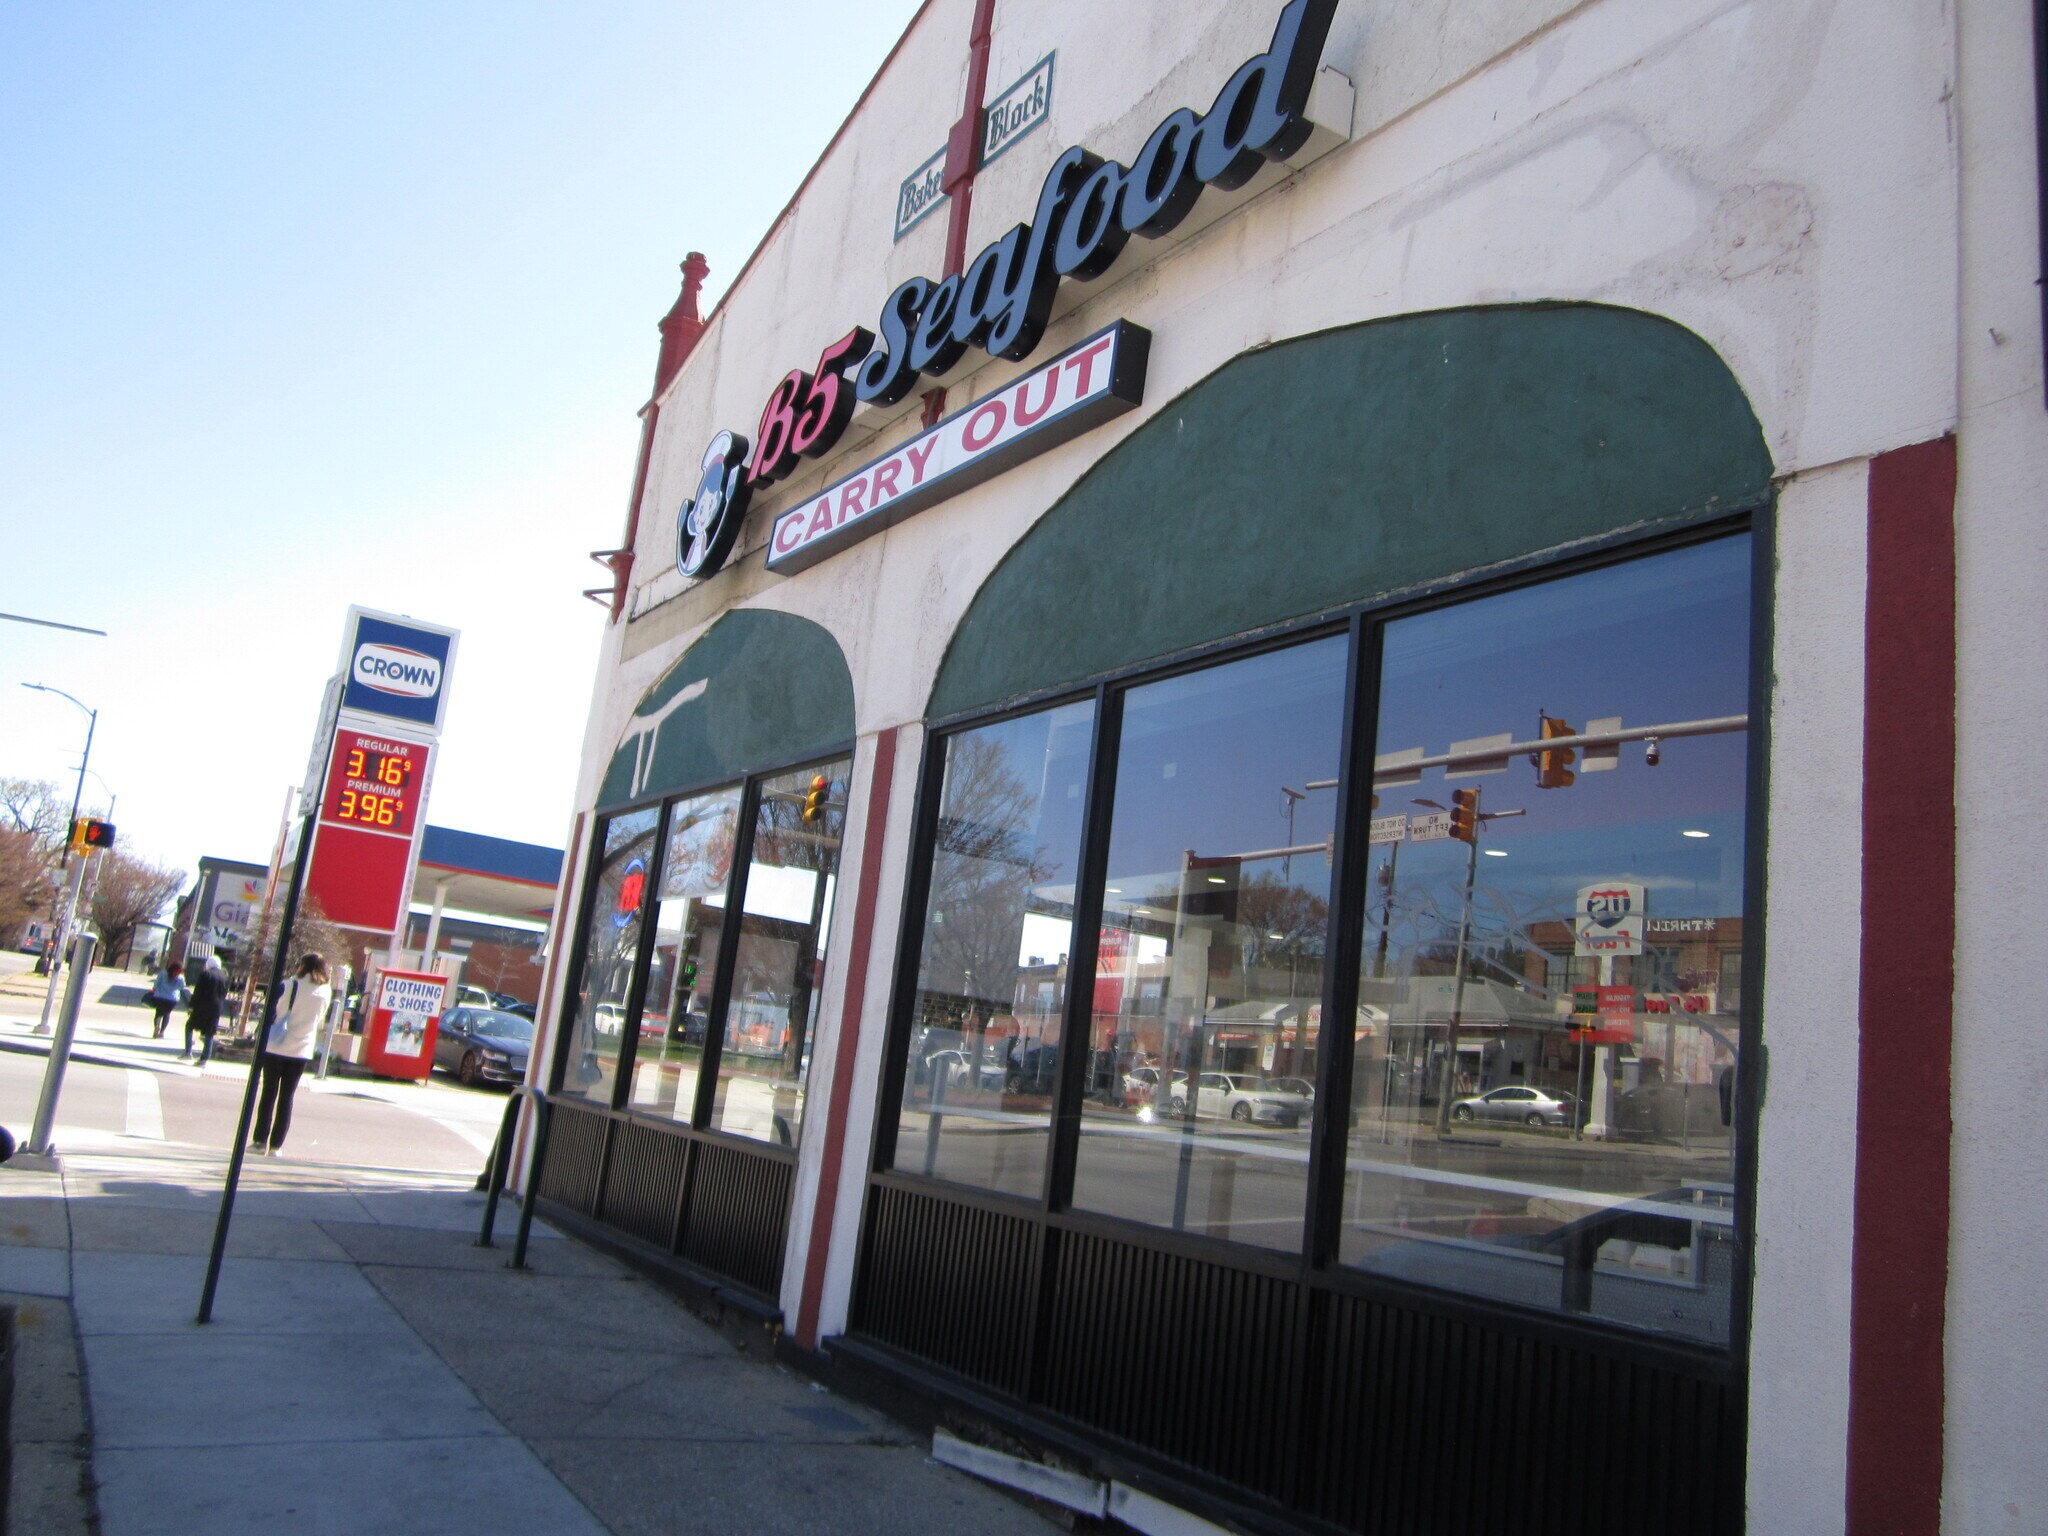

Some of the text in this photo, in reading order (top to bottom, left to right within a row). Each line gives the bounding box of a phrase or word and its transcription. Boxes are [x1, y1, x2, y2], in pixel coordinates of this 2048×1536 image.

[901, 74, 1044, 224] Bake Block
[747, 0, 1320, 485] B5 Seafood
[773, 337, 1113, 555] CARRY OUT
[359, 655, 436, 688] CROWN
[356, 737, 408, 756] REGULAR
[347, 779, 402, 798] PREMIUM
[385, 978, 442, 1000] CLOTHING
[386, 994, 434, 1013] & SHOES
